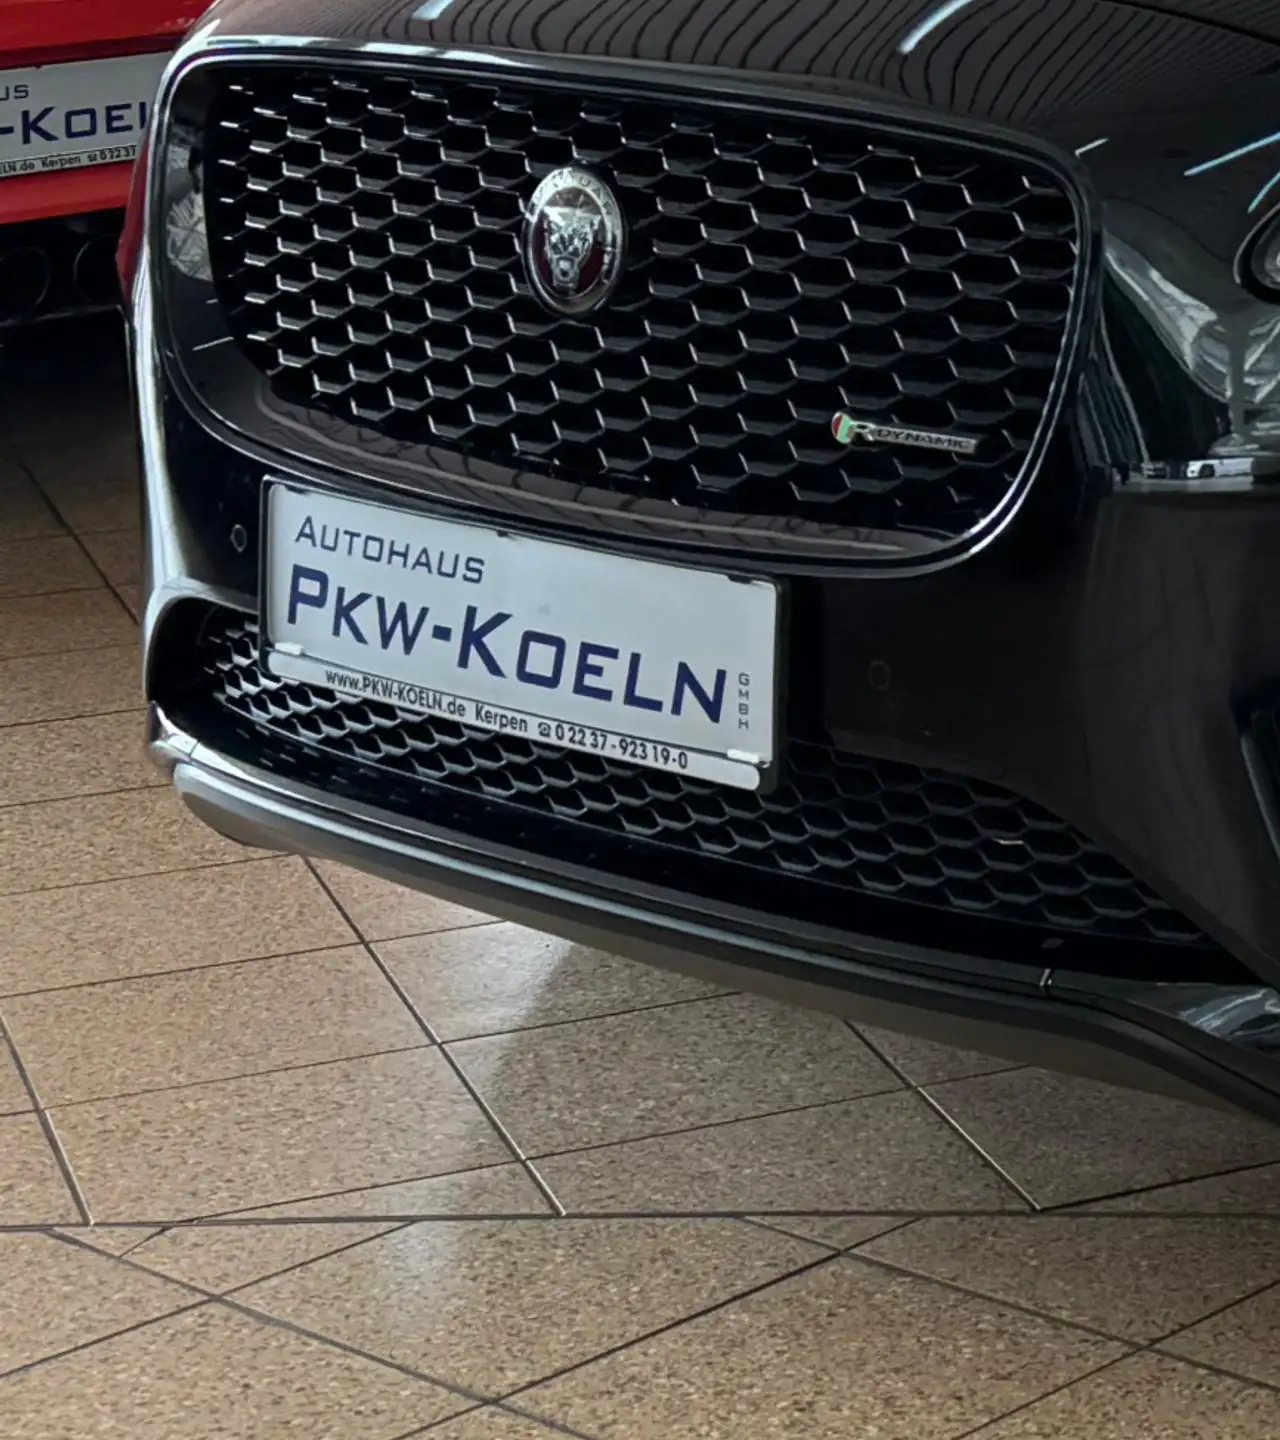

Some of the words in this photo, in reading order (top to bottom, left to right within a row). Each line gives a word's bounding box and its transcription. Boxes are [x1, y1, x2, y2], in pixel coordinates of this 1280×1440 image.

[295, 516, 485, 584] AUTOHAUS
[287, 563, 727, 724] PKW-KOELN
[325, 670, 467, 717] www.PKW-KOELN.de
[475, 703, 528, 733] Kerpen
